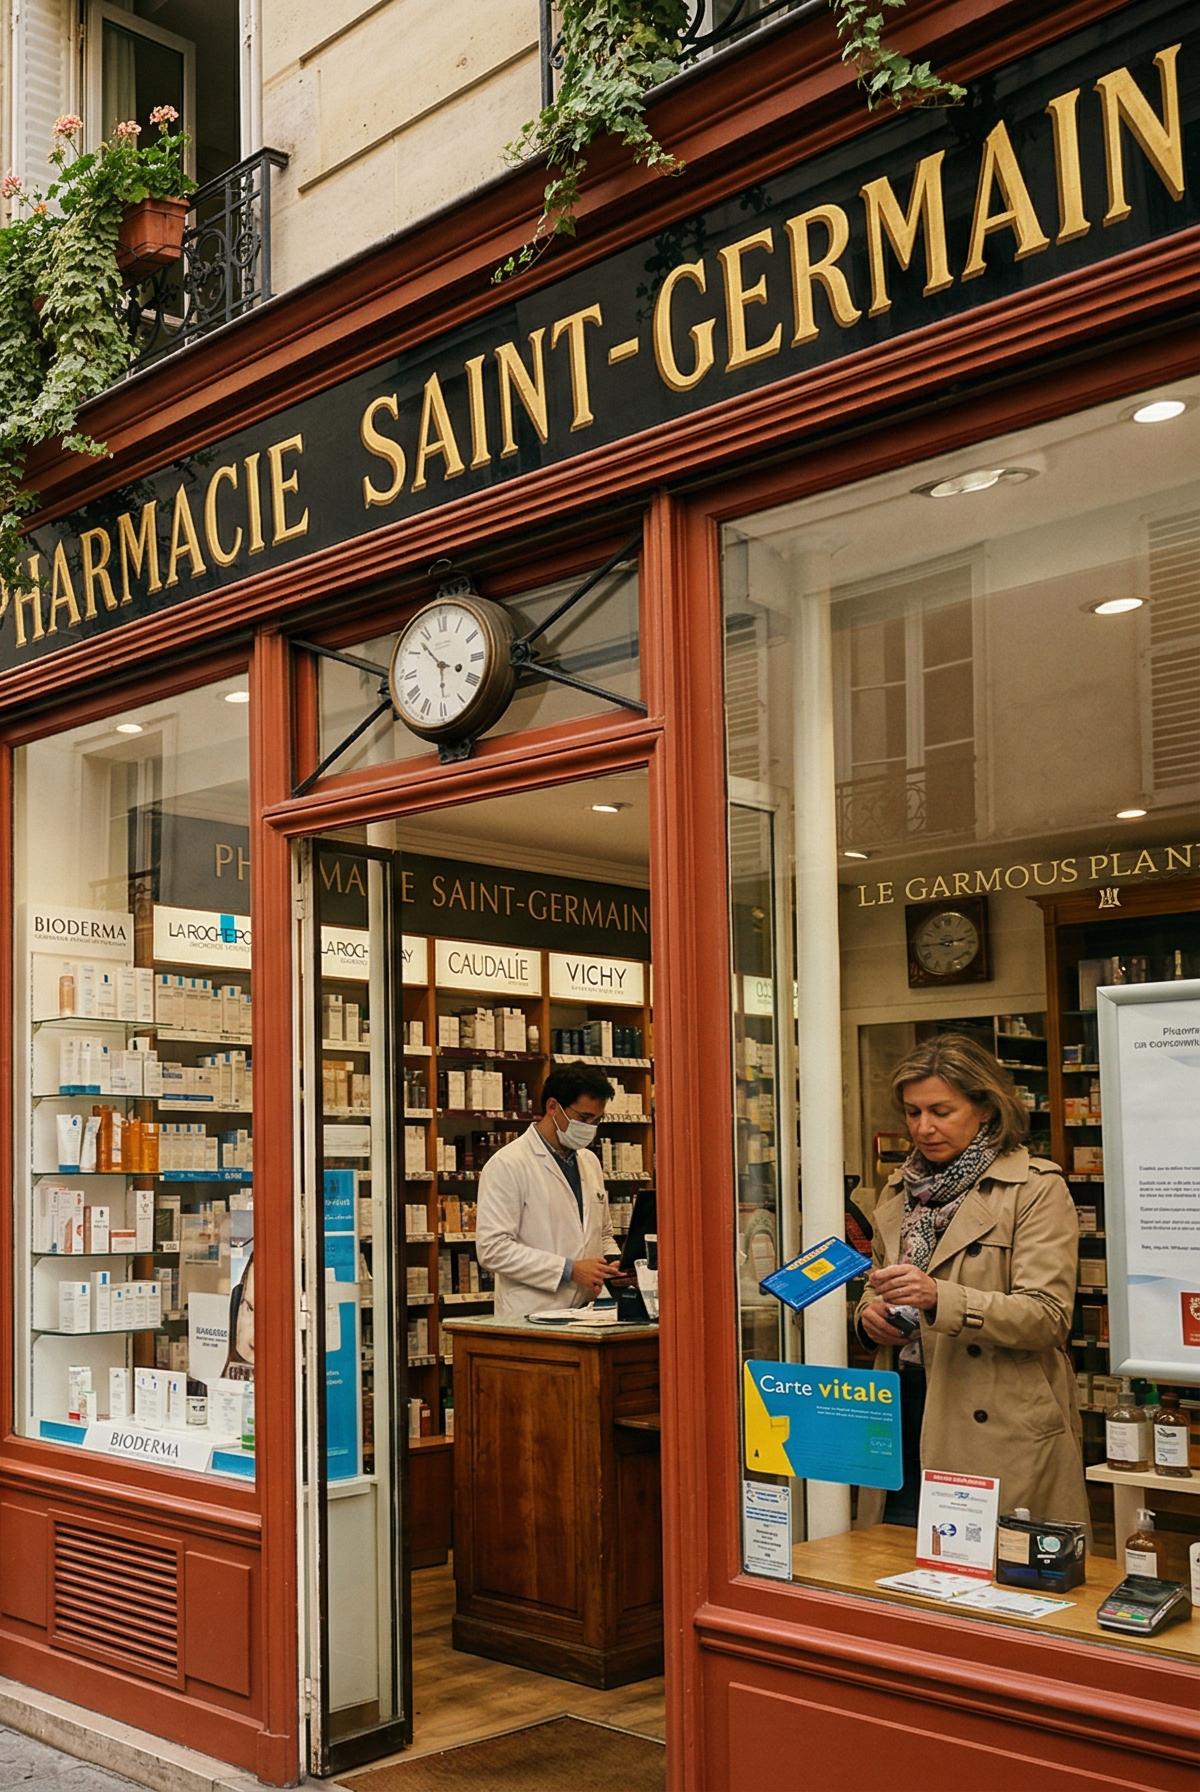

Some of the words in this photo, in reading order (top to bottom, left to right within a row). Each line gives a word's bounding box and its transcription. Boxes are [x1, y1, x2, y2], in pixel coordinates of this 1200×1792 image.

[360, 43, 1186, 509] SAINT-GERMAIN
[857, 881, 895, 907] LE
[905, 858, 1078, 900] GARMOUS
[1089, 843, 1200, 879] PLAN
[432, 875, 649, 934] SAINT-GERMAIN
[34, 916, 127, 940] BIODERMA
[566, 962, 627, 988] VICHY
[760, 1375, 813, 1396] Carte
[818, 1378, 893, 1404] vitale
[110, 1432, 179, 1458] BIODERMA
